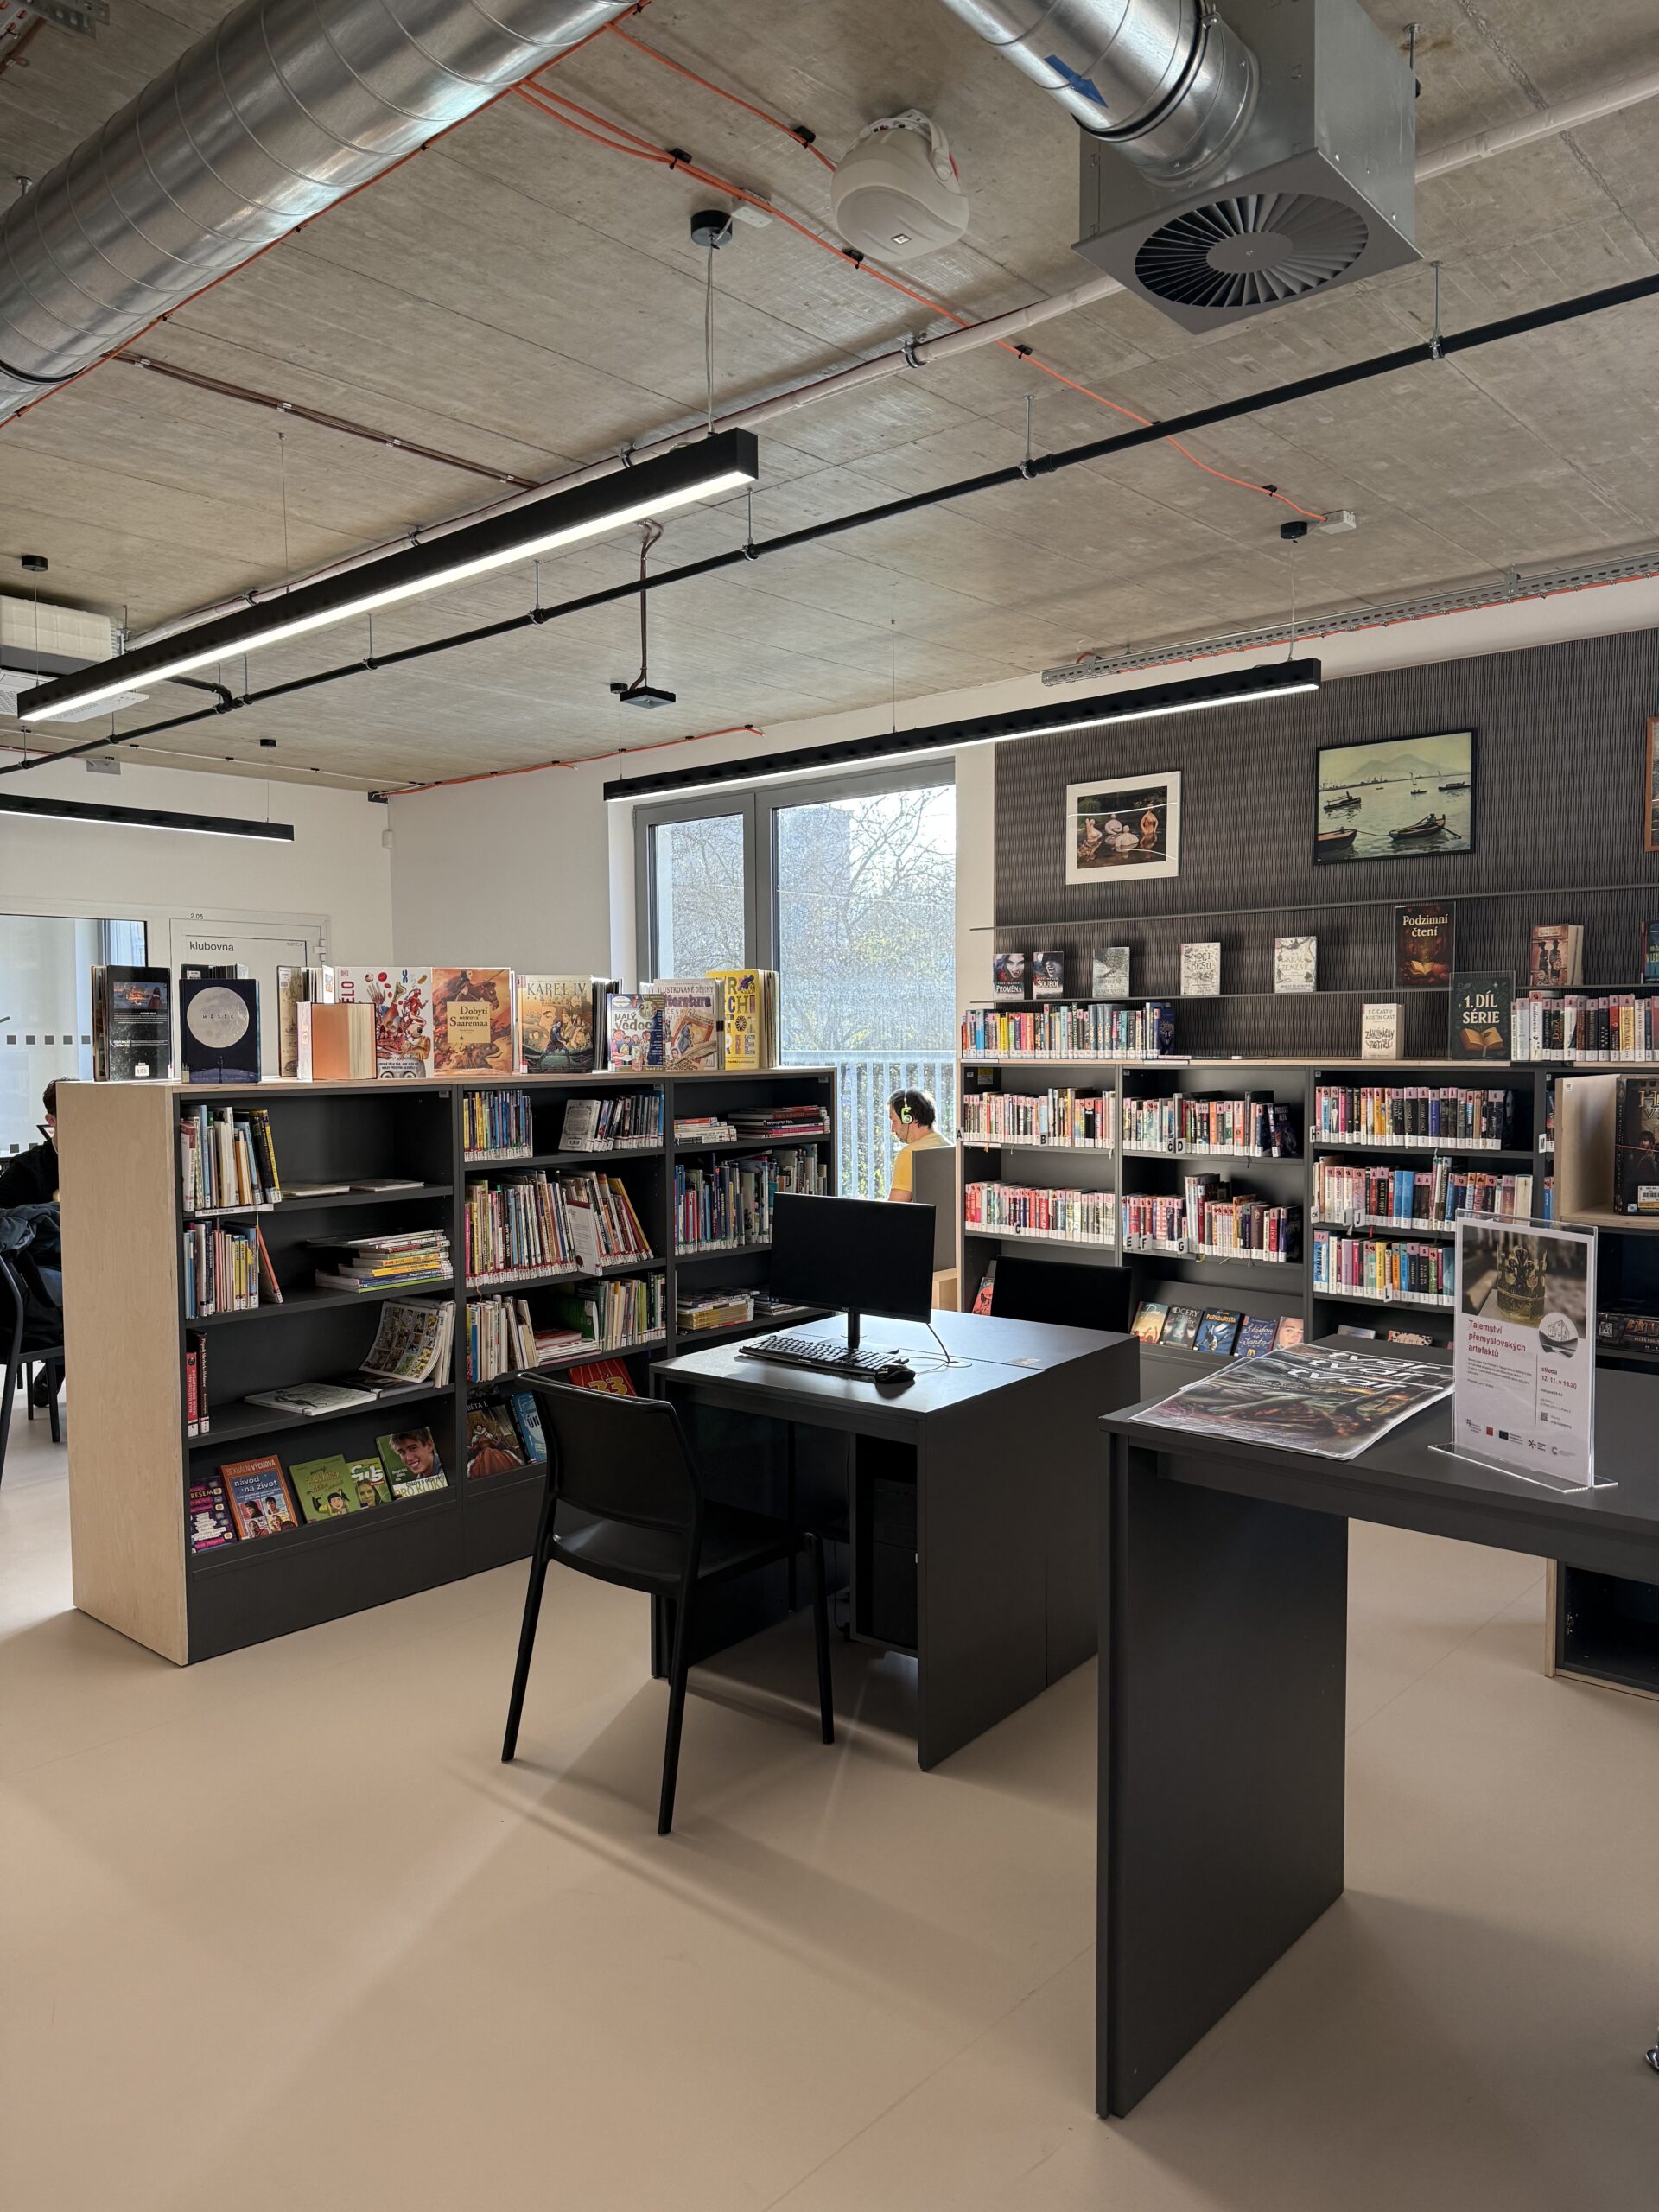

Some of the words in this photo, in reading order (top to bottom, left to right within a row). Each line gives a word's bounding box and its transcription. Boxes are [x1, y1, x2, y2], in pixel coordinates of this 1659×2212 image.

[1402, 913, 1449, 926] Podzimní
[1411, 925, 1439, 938] čtení
[189, 941, 234, 952] klubovna
[338, 981, 355, 1003] ĚLO
[527, 982, 567, 995] KAREL
[574, 982, 586, 995] IV
[1464, 995, 1474, 1008] 1.
[1475, 989, 1498, 1008] DÍL
[460, 1006, 488, 1015] Dobytí
[1462, 1007, 1500, 1025] SÉRIE
[449, 1016, 488, 1027] Saaremaa
[956, 1129, 963, 1140] A
[1040, 1135, 1046, 1145] B
[1167, 1141, 1173, 1152] Č
[1177, 1141, 1184, 1152] D
[1356, 1212, 1362, 1224] J
[1015, 1224, 1021, 1234] C
[1127, 1236, 1132, 1247] E
[1141, 1237, 1147, 1249] F
[1179, 1241, 1185, 1252] G
[1385, 1286, 1390, 1299] L
[1468, 1319, 1503, 1334] Tajemství
[1468, 1332, 1526, 1352] přemyslovských
[1468, 1344, 1500, 1358] artefaktů
[1328, 1351, 1441, 1370] tvar
[1308, 1359, 1425, 1377] tvar
[1541, 1366, 1558, 1376] středa
[1287, 1368, 1408, 1389] tvar
[467, 1402, 483, 1411] BĚTA
[234, 1474, 260, 1487] návod
[256, 1479, 278, 1491] život
